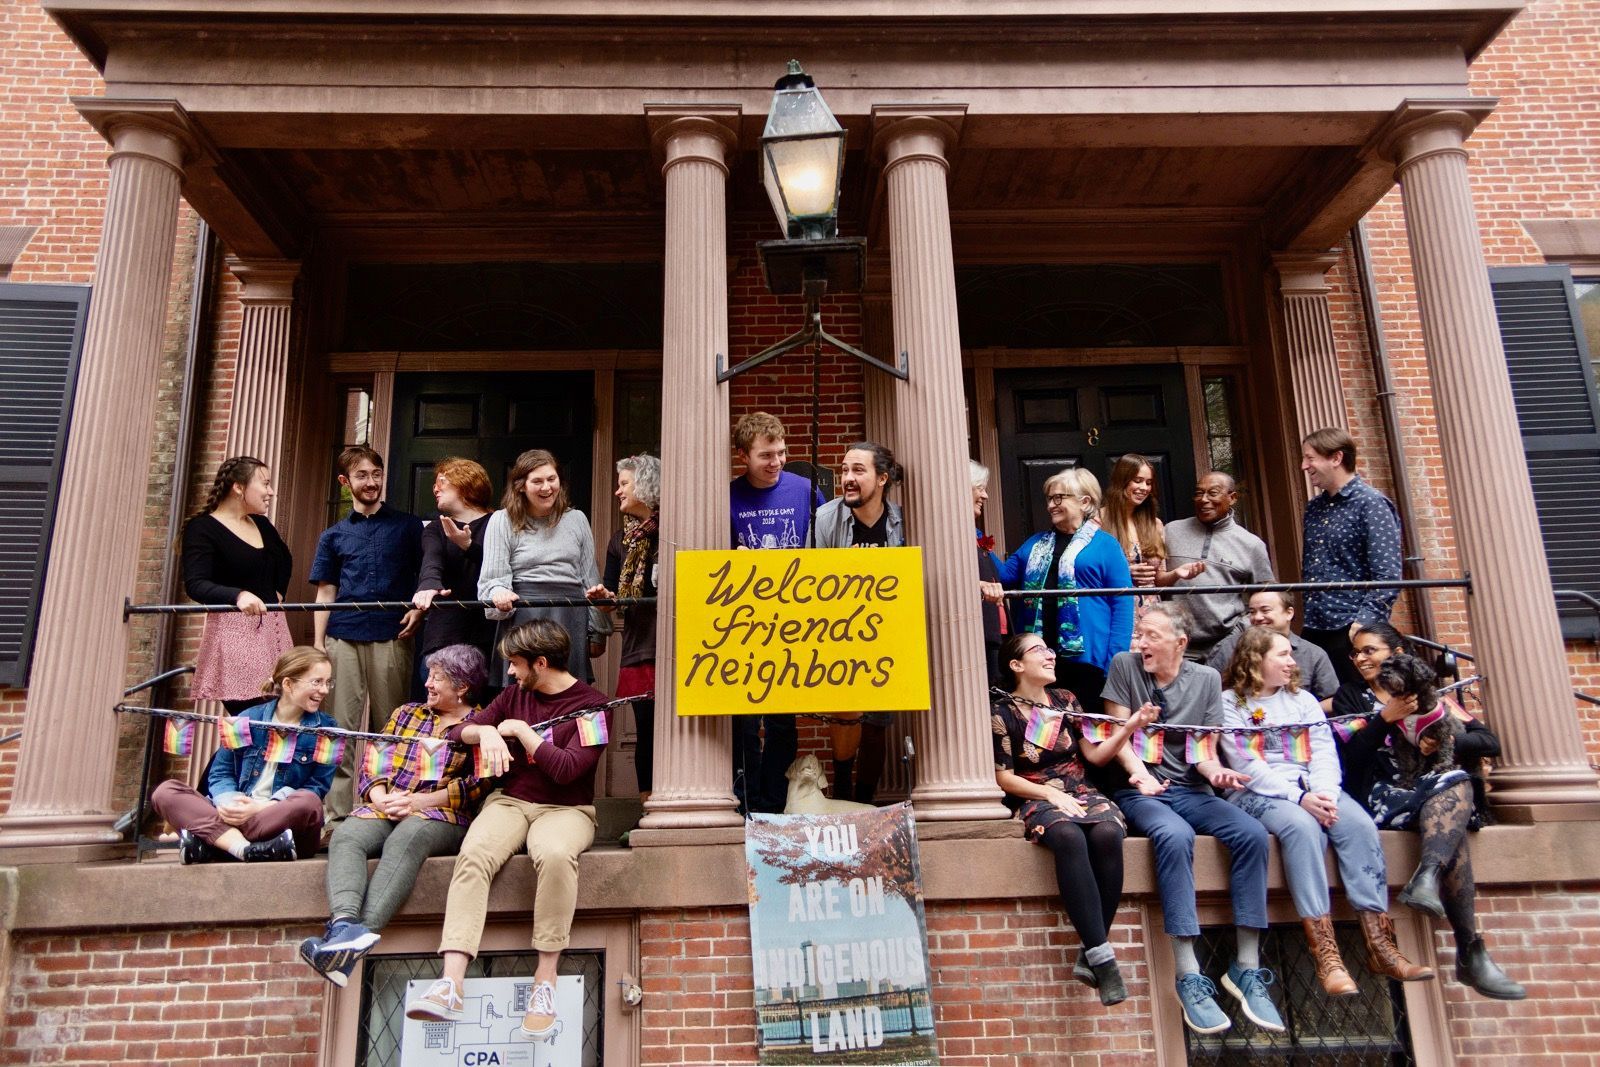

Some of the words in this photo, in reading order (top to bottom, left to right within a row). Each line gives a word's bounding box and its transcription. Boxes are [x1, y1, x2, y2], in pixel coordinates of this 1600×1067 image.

[1088, 428, 1099, 446] 8
[705, 557, 899, 607] Welcome
[701, 604, 883, 650] friends
[684, 648, 894, 704] neighbors
[805, 824, 858, 857] YOU
[788, 882, 843, 923] ARE
[848, 875, 885, 918] ON
[758, 936, 925, 987] INDIGENOUS
[810, 1006, 883, 1053] LAND
[464, 1051, 500, 1066] CPA
